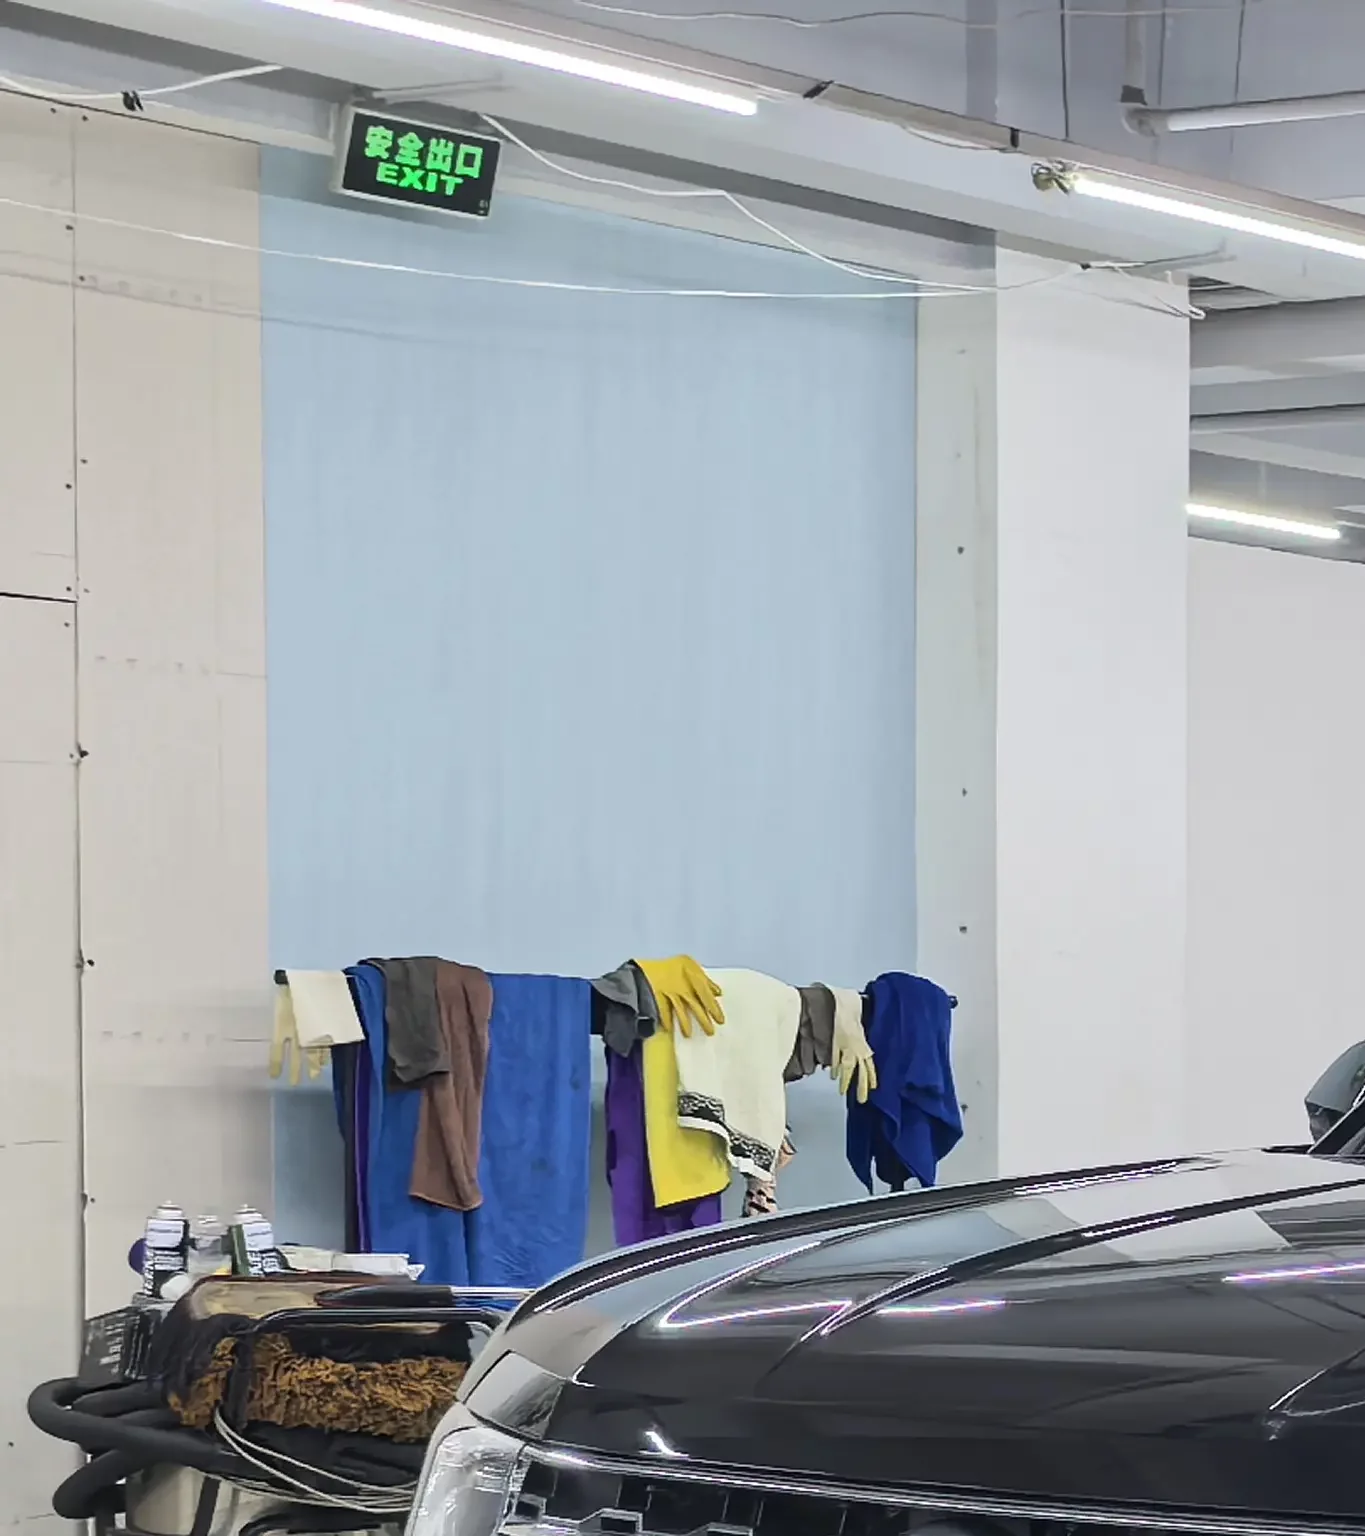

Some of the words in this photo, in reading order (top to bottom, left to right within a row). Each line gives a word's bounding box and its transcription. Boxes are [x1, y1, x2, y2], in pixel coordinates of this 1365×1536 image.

[364, 125, 483, 178] 安全出口
[376, 161, 463, 195] EXIT
